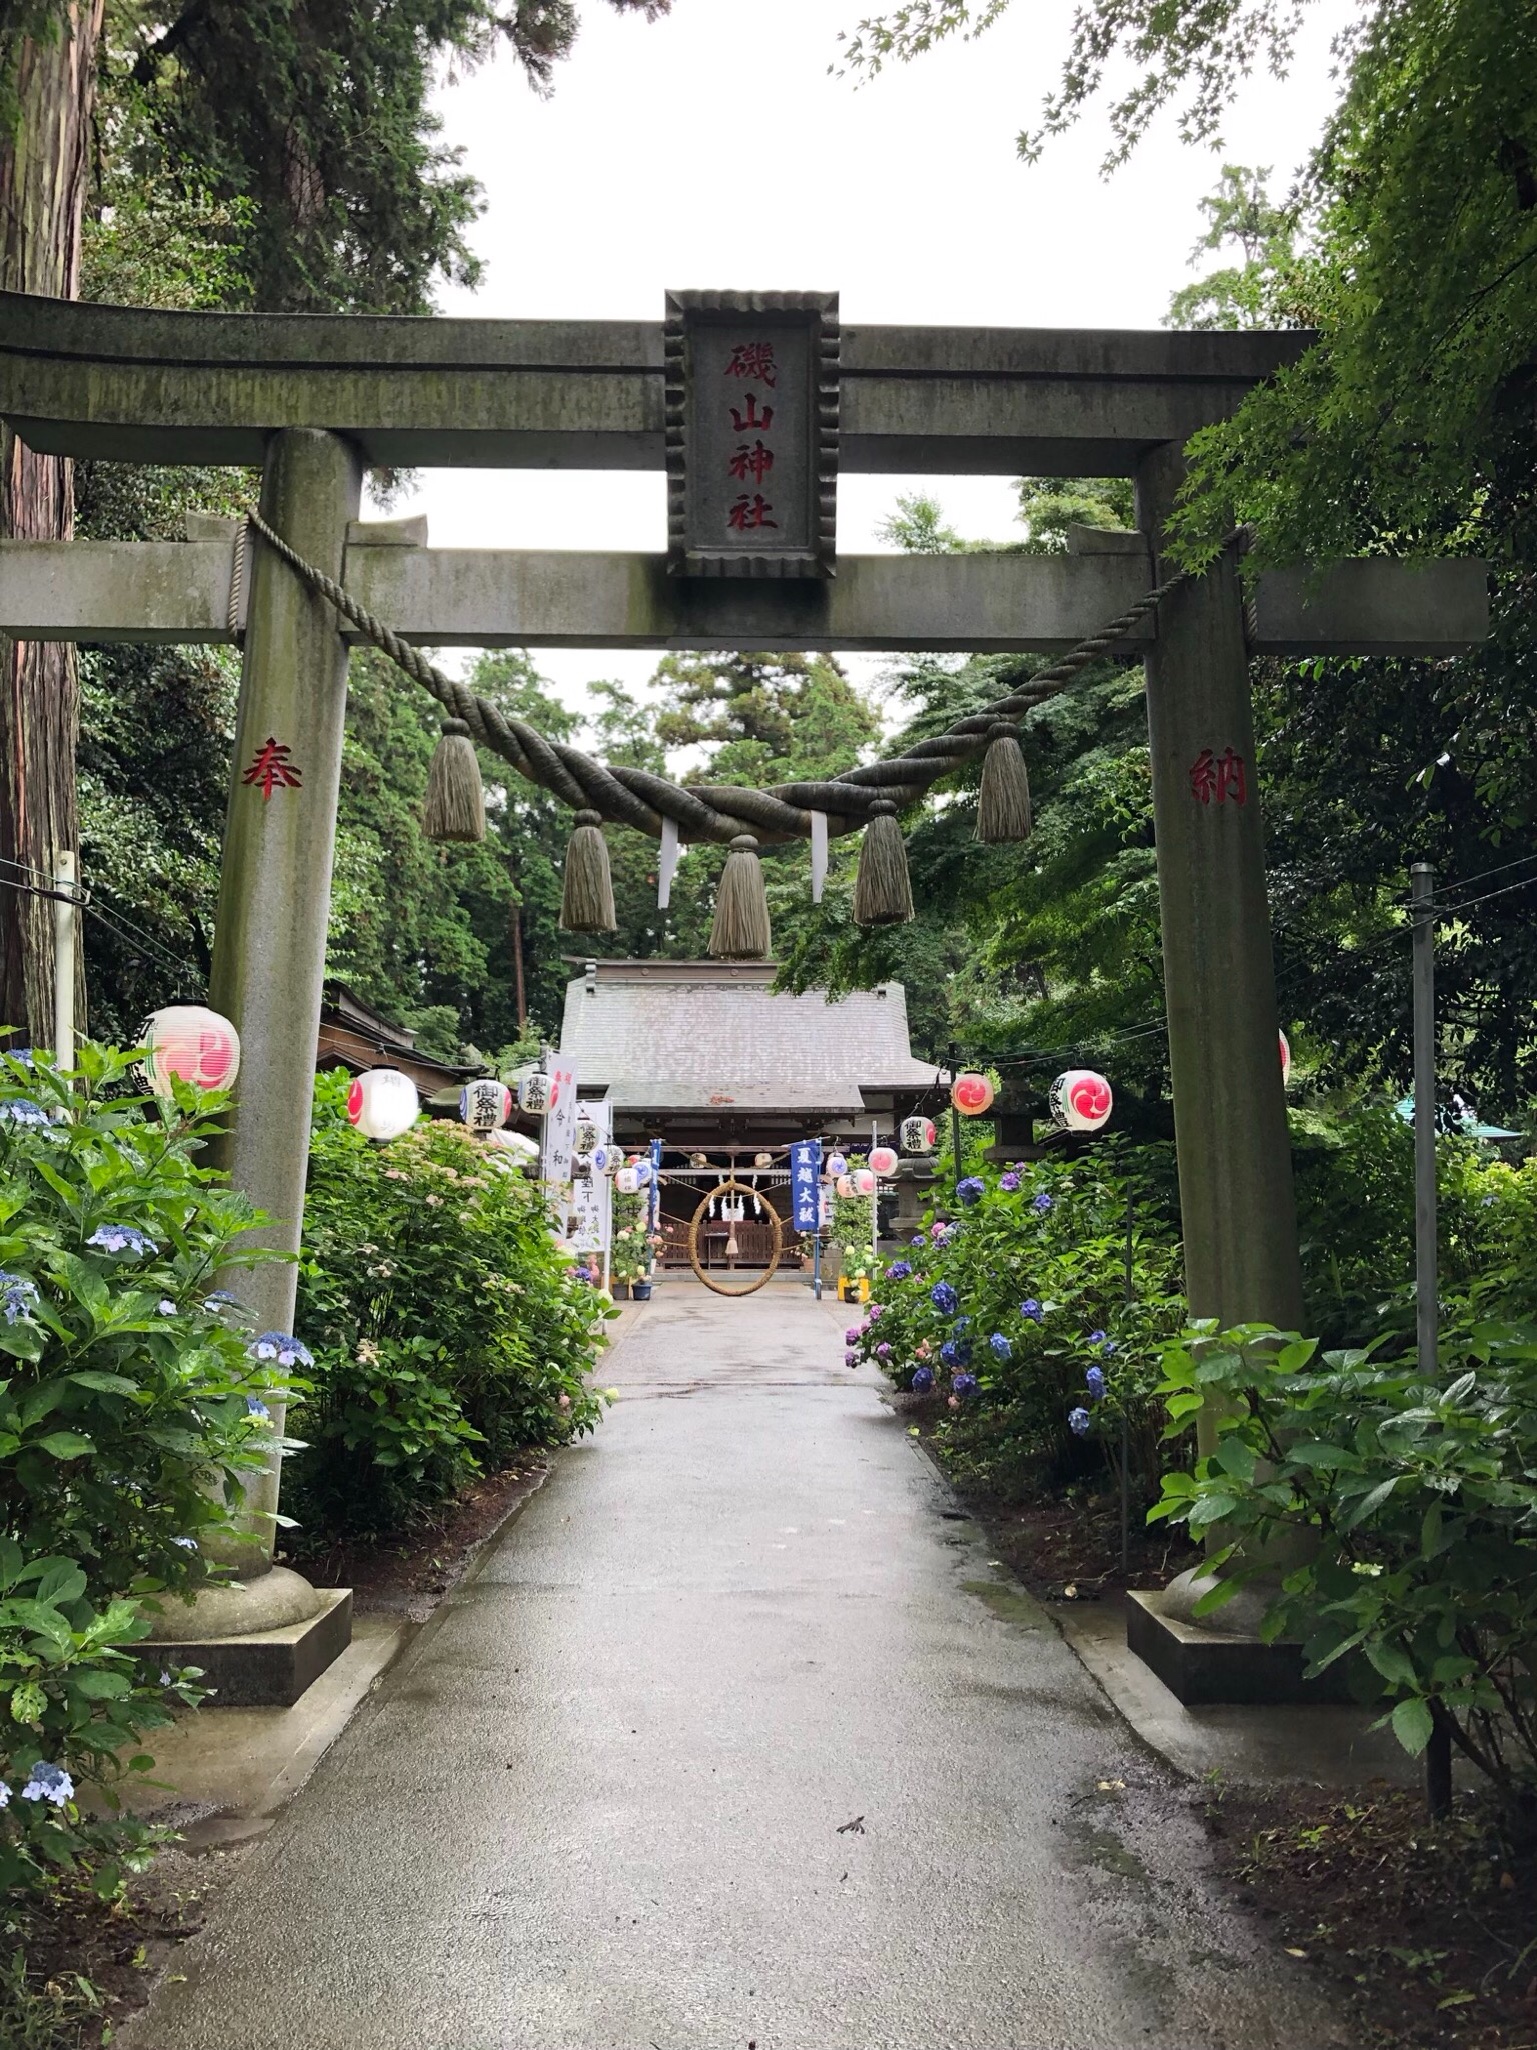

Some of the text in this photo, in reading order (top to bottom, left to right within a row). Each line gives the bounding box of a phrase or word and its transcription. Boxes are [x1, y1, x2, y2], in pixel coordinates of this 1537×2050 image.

[724, 342, 778, 532] 磯山神社
[242, 737, 303, 801] 奉
[1189, 746, 1247, 806] 納
[473, 1084, 498, 1127] 御祭禮
[904, 1120, 922, 1149] 御祭禮
[553, 1108, 565, 1167] 令和
[797, 1147, 816, 1223] 夏越大祓
